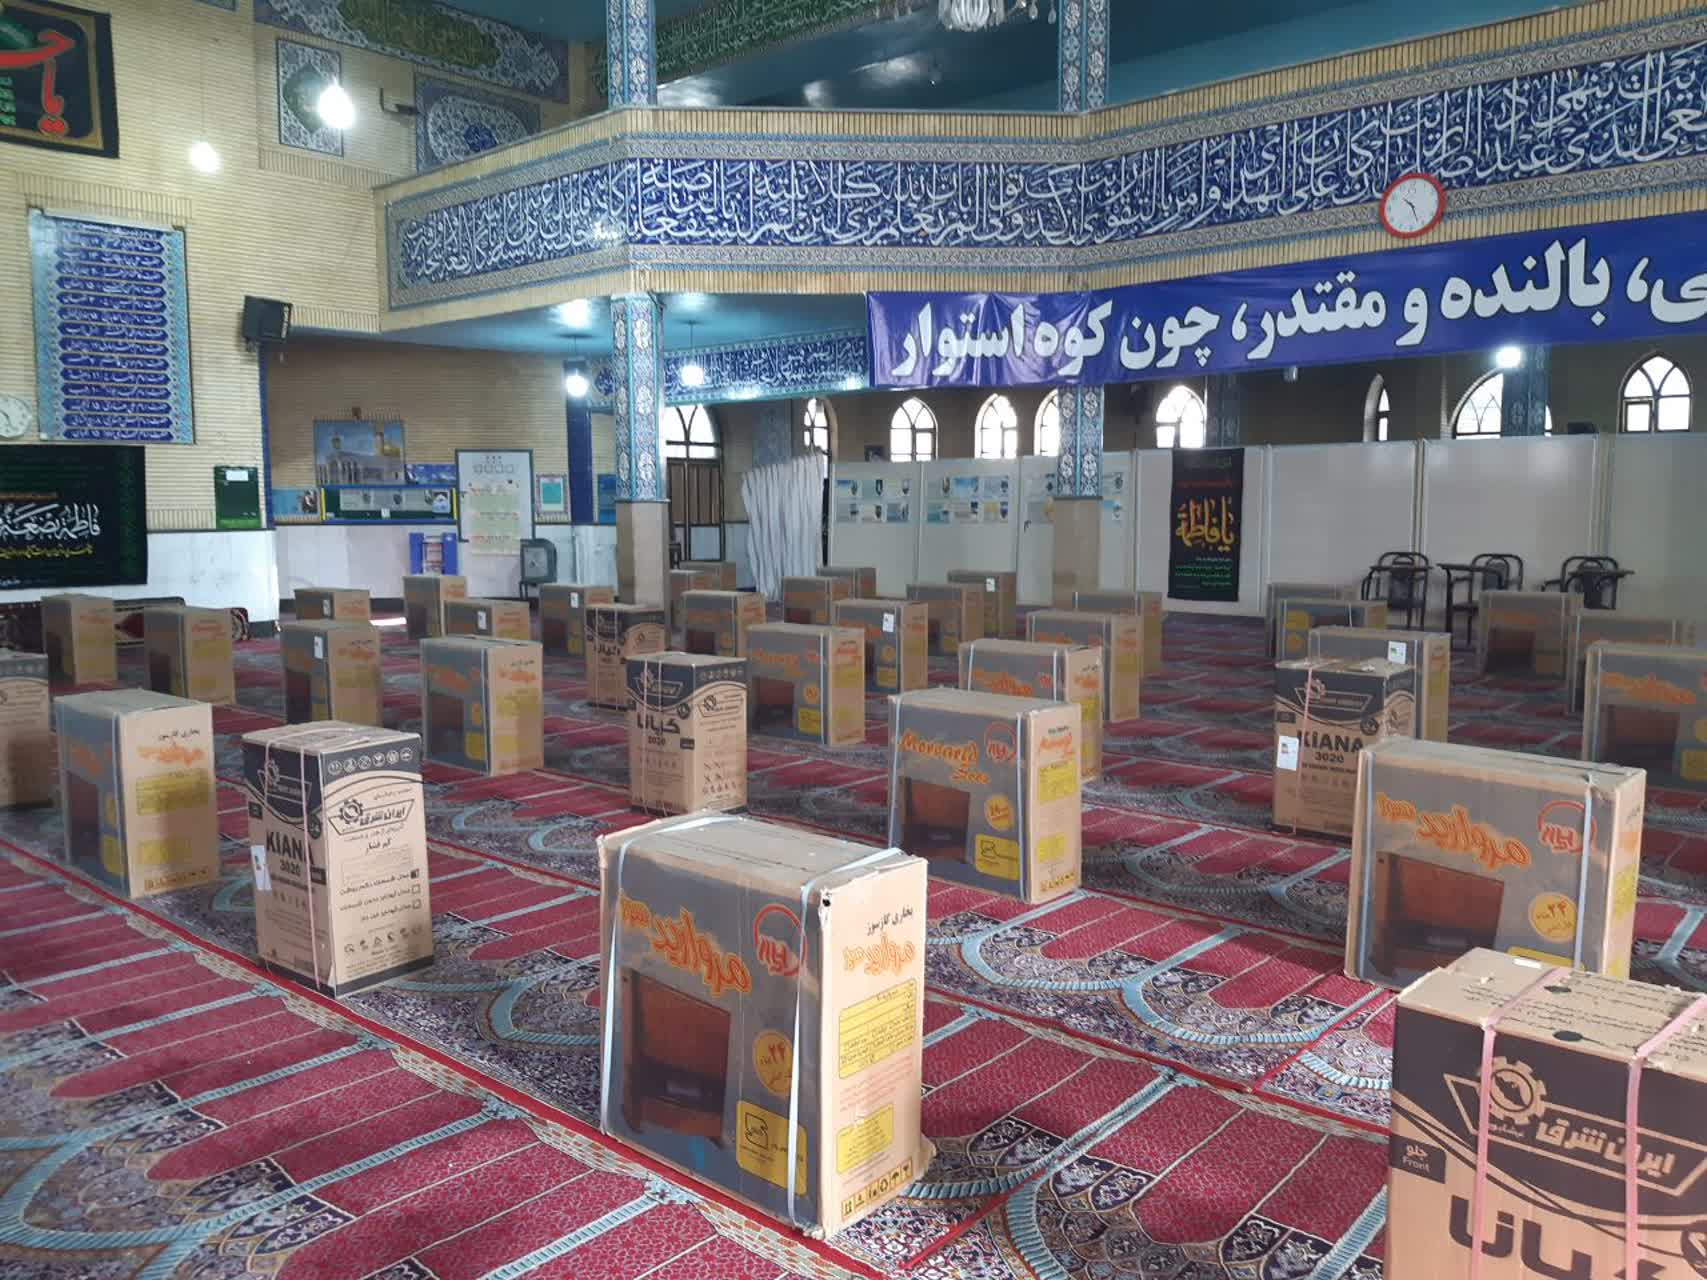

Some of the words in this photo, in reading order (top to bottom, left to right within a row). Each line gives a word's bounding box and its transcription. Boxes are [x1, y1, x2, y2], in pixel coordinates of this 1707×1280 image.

[1441, 237, 1611, 326] بالنده
[892, 301, 1026, 377] استوار
[1034, 300, 1113, 376] کوه
[1119, 305, 1220, 370] چون
[1395, 287, 1428, 346] و
[637, 713, 681, 736] کیانا
[1402, 1155, 1430, 1172] Front
[1406, 1143, 1428, 1159] جلو
